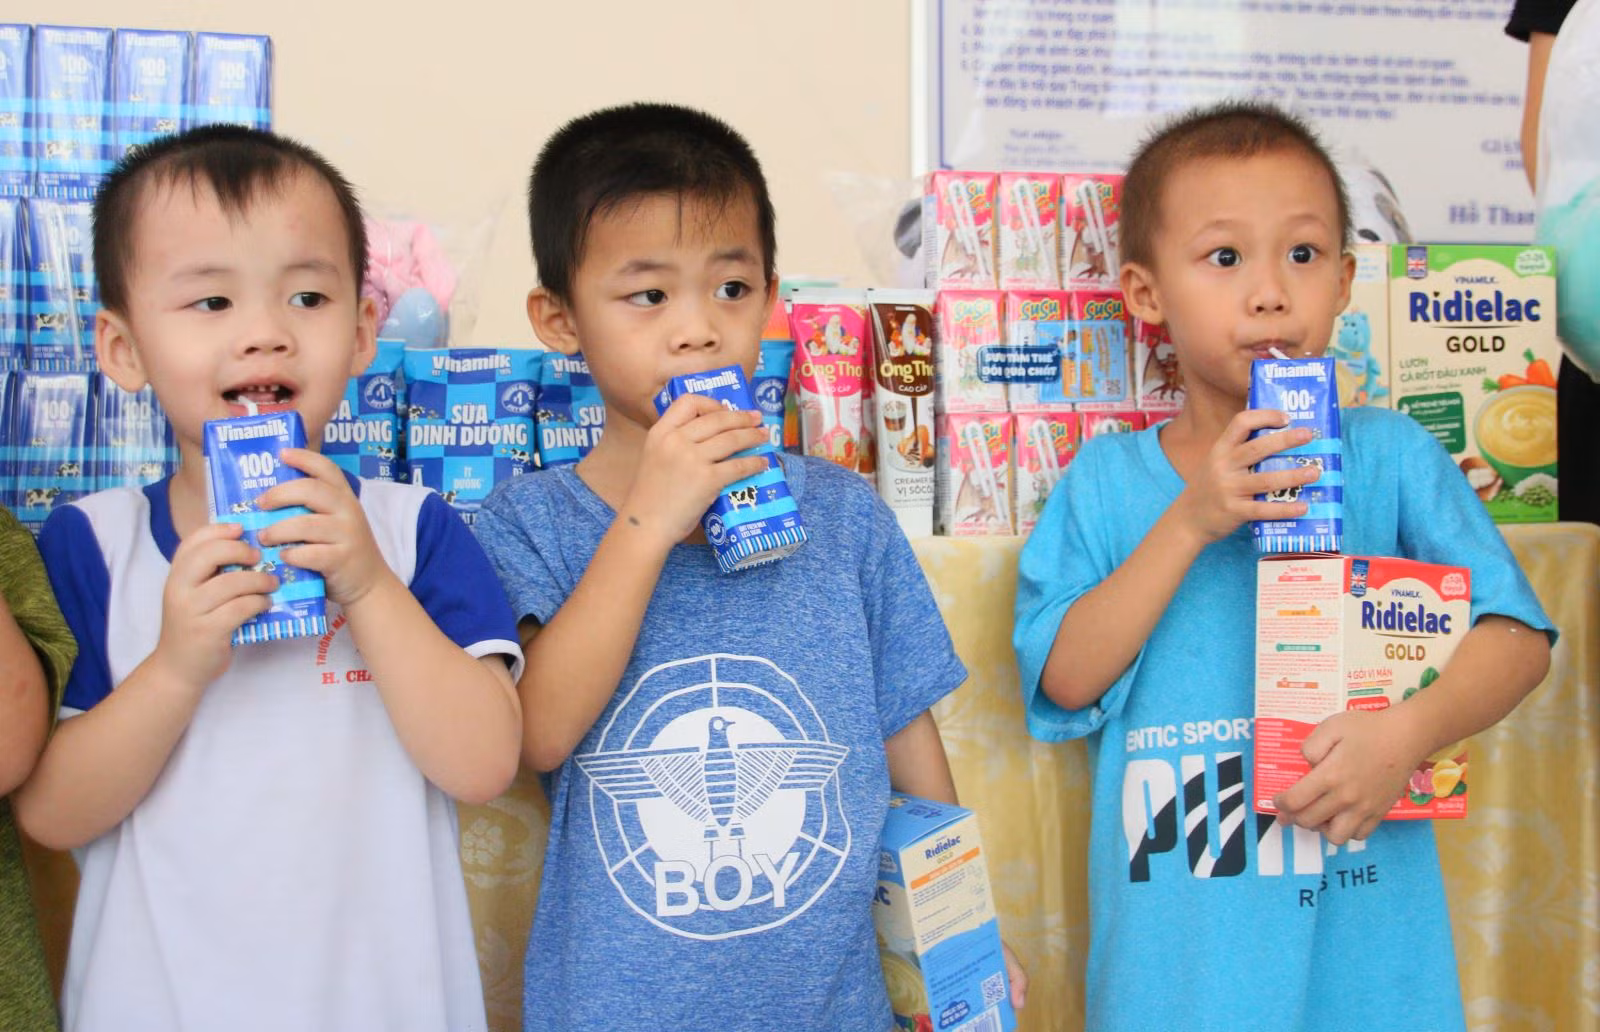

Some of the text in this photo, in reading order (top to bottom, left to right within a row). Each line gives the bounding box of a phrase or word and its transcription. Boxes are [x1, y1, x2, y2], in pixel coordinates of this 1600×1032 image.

[1408, 289, 1542, 323] Ridielac
[1446, 335, 1506, 354] GOLD
[431, 354, 512, 374] Vinamilk
[551, 357, 591, 374] Vina
[880, 358, 915, 383] Ông
[1263, 361, 1327, 379] Vinamilk
[684, 370, 740, 393] Vinamilk
[216, 418, 289, 442] Vinamilk
[410, 424, 457, 447] DINH
[542, 427, 589, 449] DINH
[1361, 600, 1452, 635] Ridielac
[1384, 642, 1427, 662] GOLD
[322, 671, 340, 685] H.
[1183, 717, 1256, 745] SPOR
[925, 835, 961, 860] Ridielac
[654, 851, 801, 917] BOY
[1336, 864, 1379, 889] THE
